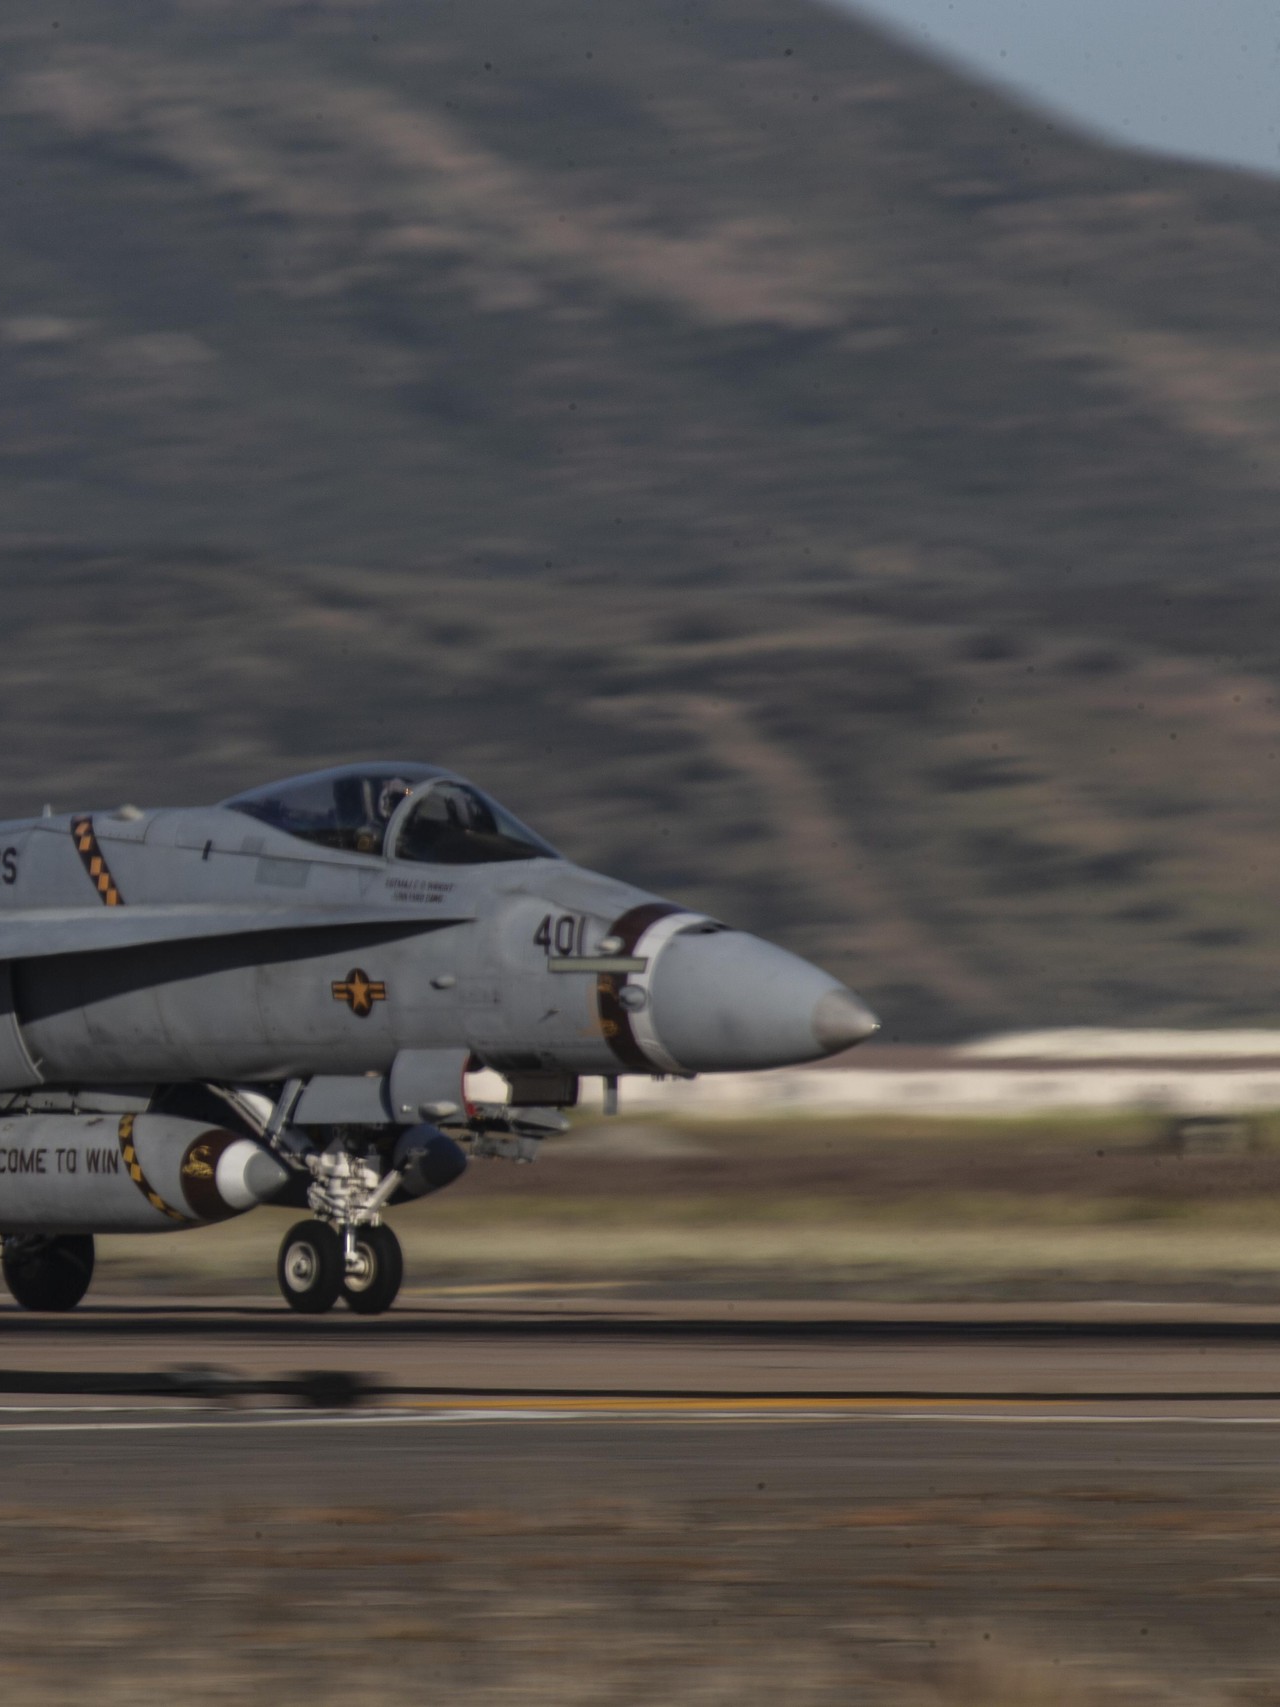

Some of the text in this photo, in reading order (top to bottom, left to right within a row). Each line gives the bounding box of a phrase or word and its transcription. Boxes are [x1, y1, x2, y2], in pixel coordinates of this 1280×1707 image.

[533, 913, 586, 957] 401
[55, 1148, 77, 1173] TO
[86, 1147, 119, 1174] WIN
